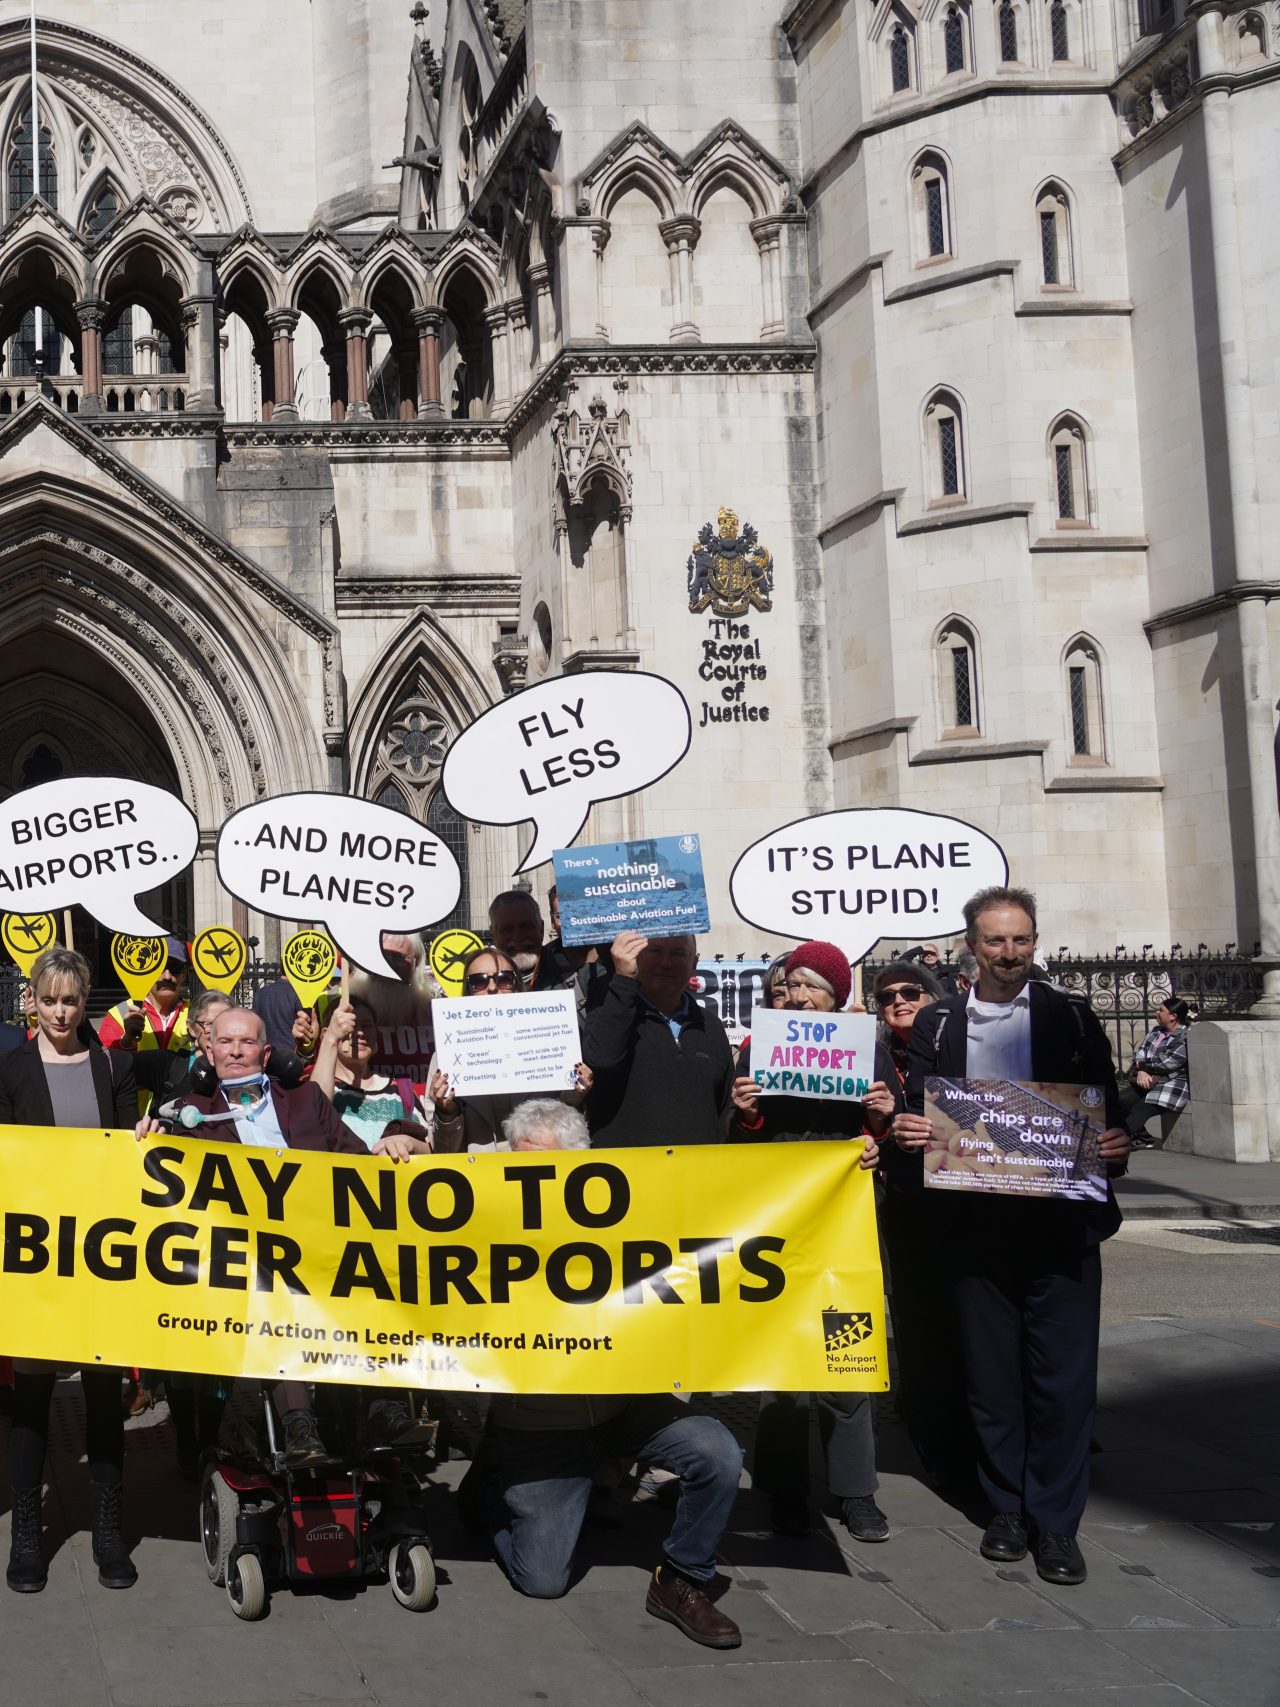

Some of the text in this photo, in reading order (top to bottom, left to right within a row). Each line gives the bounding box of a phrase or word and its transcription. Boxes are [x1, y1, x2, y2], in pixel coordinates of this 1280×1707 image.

[708, 619, 750, 640] The
[701, 638, 761, 664] Royal
[698, 660, 767, 681] Courts
[721, 681, 746, 702] of
[518, 697, 584, 747] FLY
[699, 702, 770, 727] Justice
[519, 739, 621, 796] LESS
[11, 798, 137, 845] BIGGER
[233, 823, 439, 867] ..AND MORE
[563, 857, 600, 869] There's
[767, 842, 972, 873] IT'S PLANE
[597, 861, 659, 879] nothing
[260, 868, 415, 910] PLANES?
[584, 875, 677, 897] sustainable
[617, 897, 646, 908] about
[791, 887, 939, 916] STUPID!
[570, 904, 697, 926] Sustainable Aviation Fuel
[442, 1003, 567, 1020] 'Jet Zero' is greenwash
[456, 1033, 499, 1044] Aviation Fuel
[513, 1032, 551, 1041] conventional
[552, 1030, 561, 1039] jet
[532, 1024, 560, 1033] emissions
[786, 1019, 838, 1042] STOP
[373, 1025, 434, 1056] TOP
[467, 1058, 503, 1067] technology
[539, 1052, 564, 1060] demand
[769, 1045, 856, 1070] AIRPORT
[463, 1072, 497, 1082] Offsetting
[514, 1069, 535, 1077] proven
[526, 1073, 554, 1081] effective
[754, 1069, 869, 1098] EXPANSION
[945, 1090, 1005, 1103] When the
[979, 1109, 1063, 1127] chips are
[960, 1137, 994, 1151] flying
[1020, 1129, 1072, 1145] down
[977, 1152, 1074, 1169] isn't sustainable
[140, 1145, 631, 1232] SAY NO TO
[2, 1212, 786, 1306] BIGGER AIRPORTS
[157, 1313, 613, 1355] Group for Action on Leeds Bradford Airport
[826, 1354, 877, 1364] No Airport
[827, 1363, 878, 1374] Expansion!
[305, 1532, 344, 1542] QUICKIE
